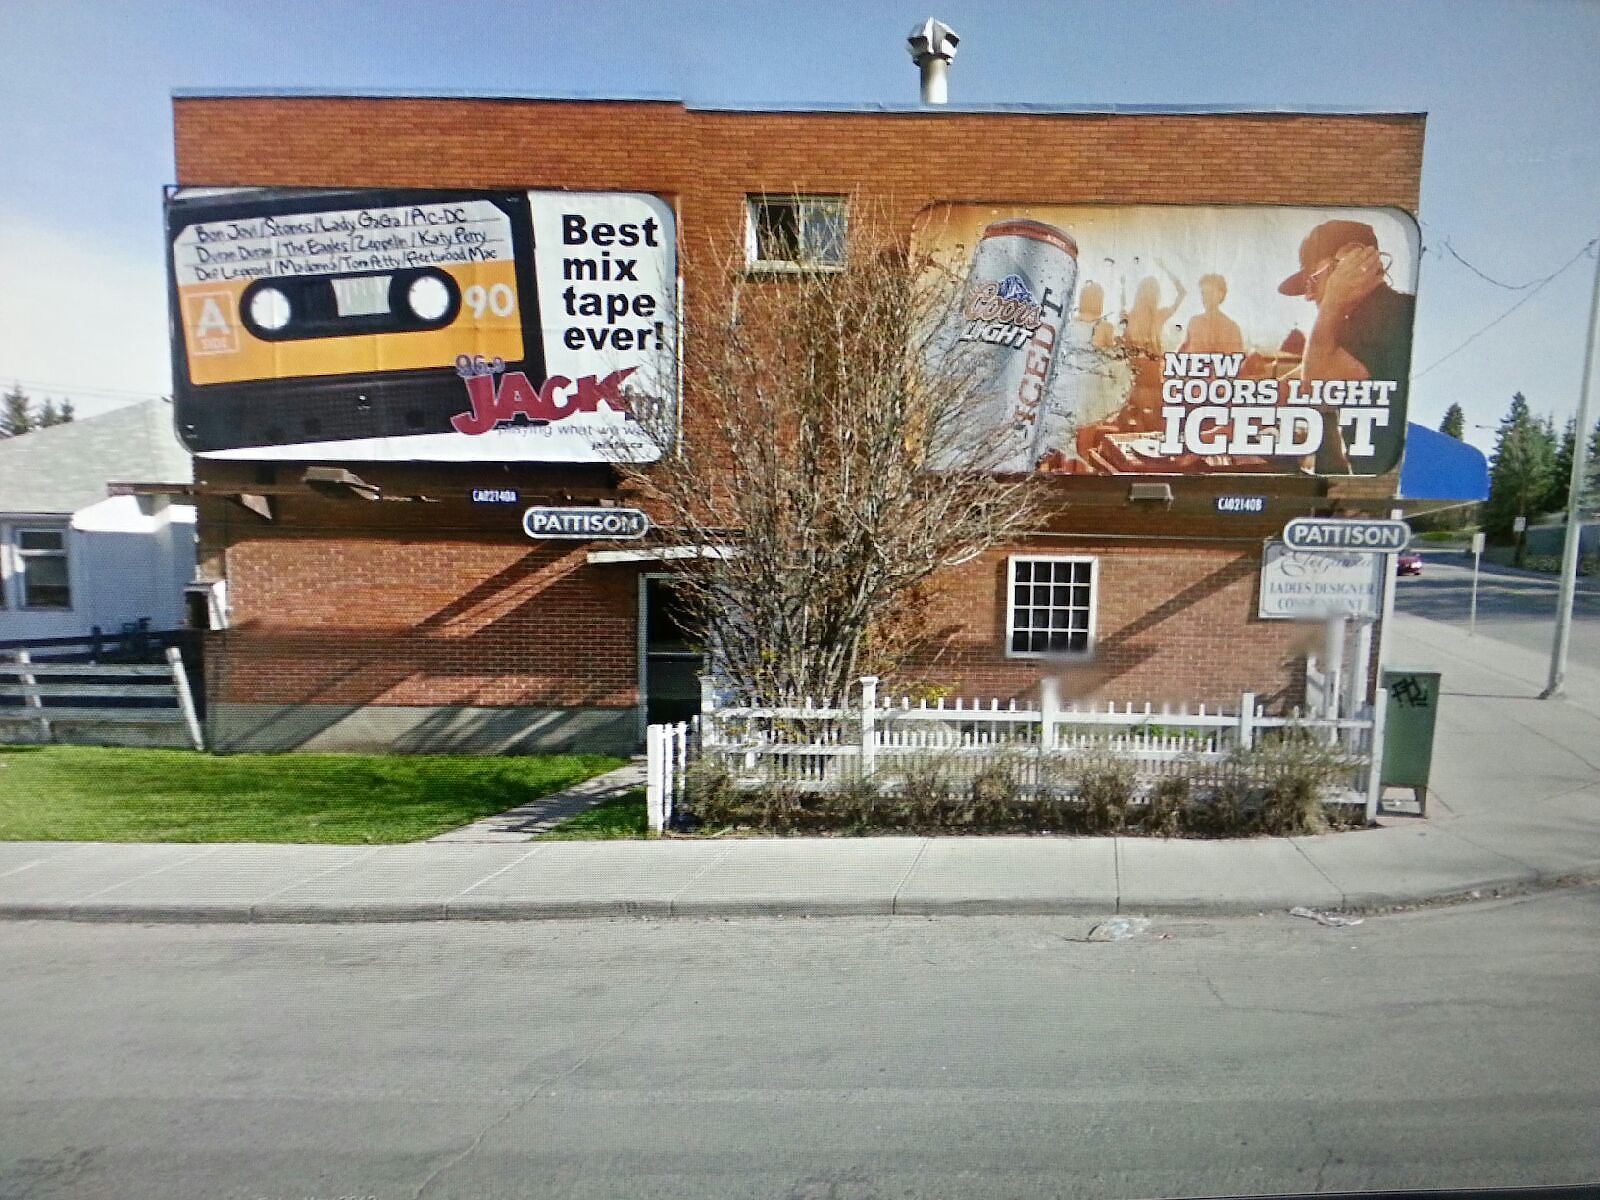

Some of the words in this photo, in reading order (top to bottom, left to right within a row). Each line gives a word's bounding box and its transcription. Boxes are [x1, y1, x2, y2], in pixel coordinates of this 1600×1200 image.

[562, 213, 659, 248] Best
[562, 252, 639, 281] mix
[464, 282, 516, 319] 90
[562, 285, 656, 324] tape
[197, 298, 230, 337] A
[563, 321, 664, 351] ever!
[959, 320, 1036, 350] LIGHT
[1163, 352, 1245, 378] NEW
[450, 366, 640, 436] JACK
[1162, 379, 1279, 405] COORS
[1287, 380, 1398, 406] LIGHT
[1160, 406, 1324, 456] ICED
[1338, 408, 1390, 457] T
[533, 514, 638, 532] PATTISON
[1294, 525, 1400, 546] PATTISON
[1270, 582, 1312, 594] LADIES
